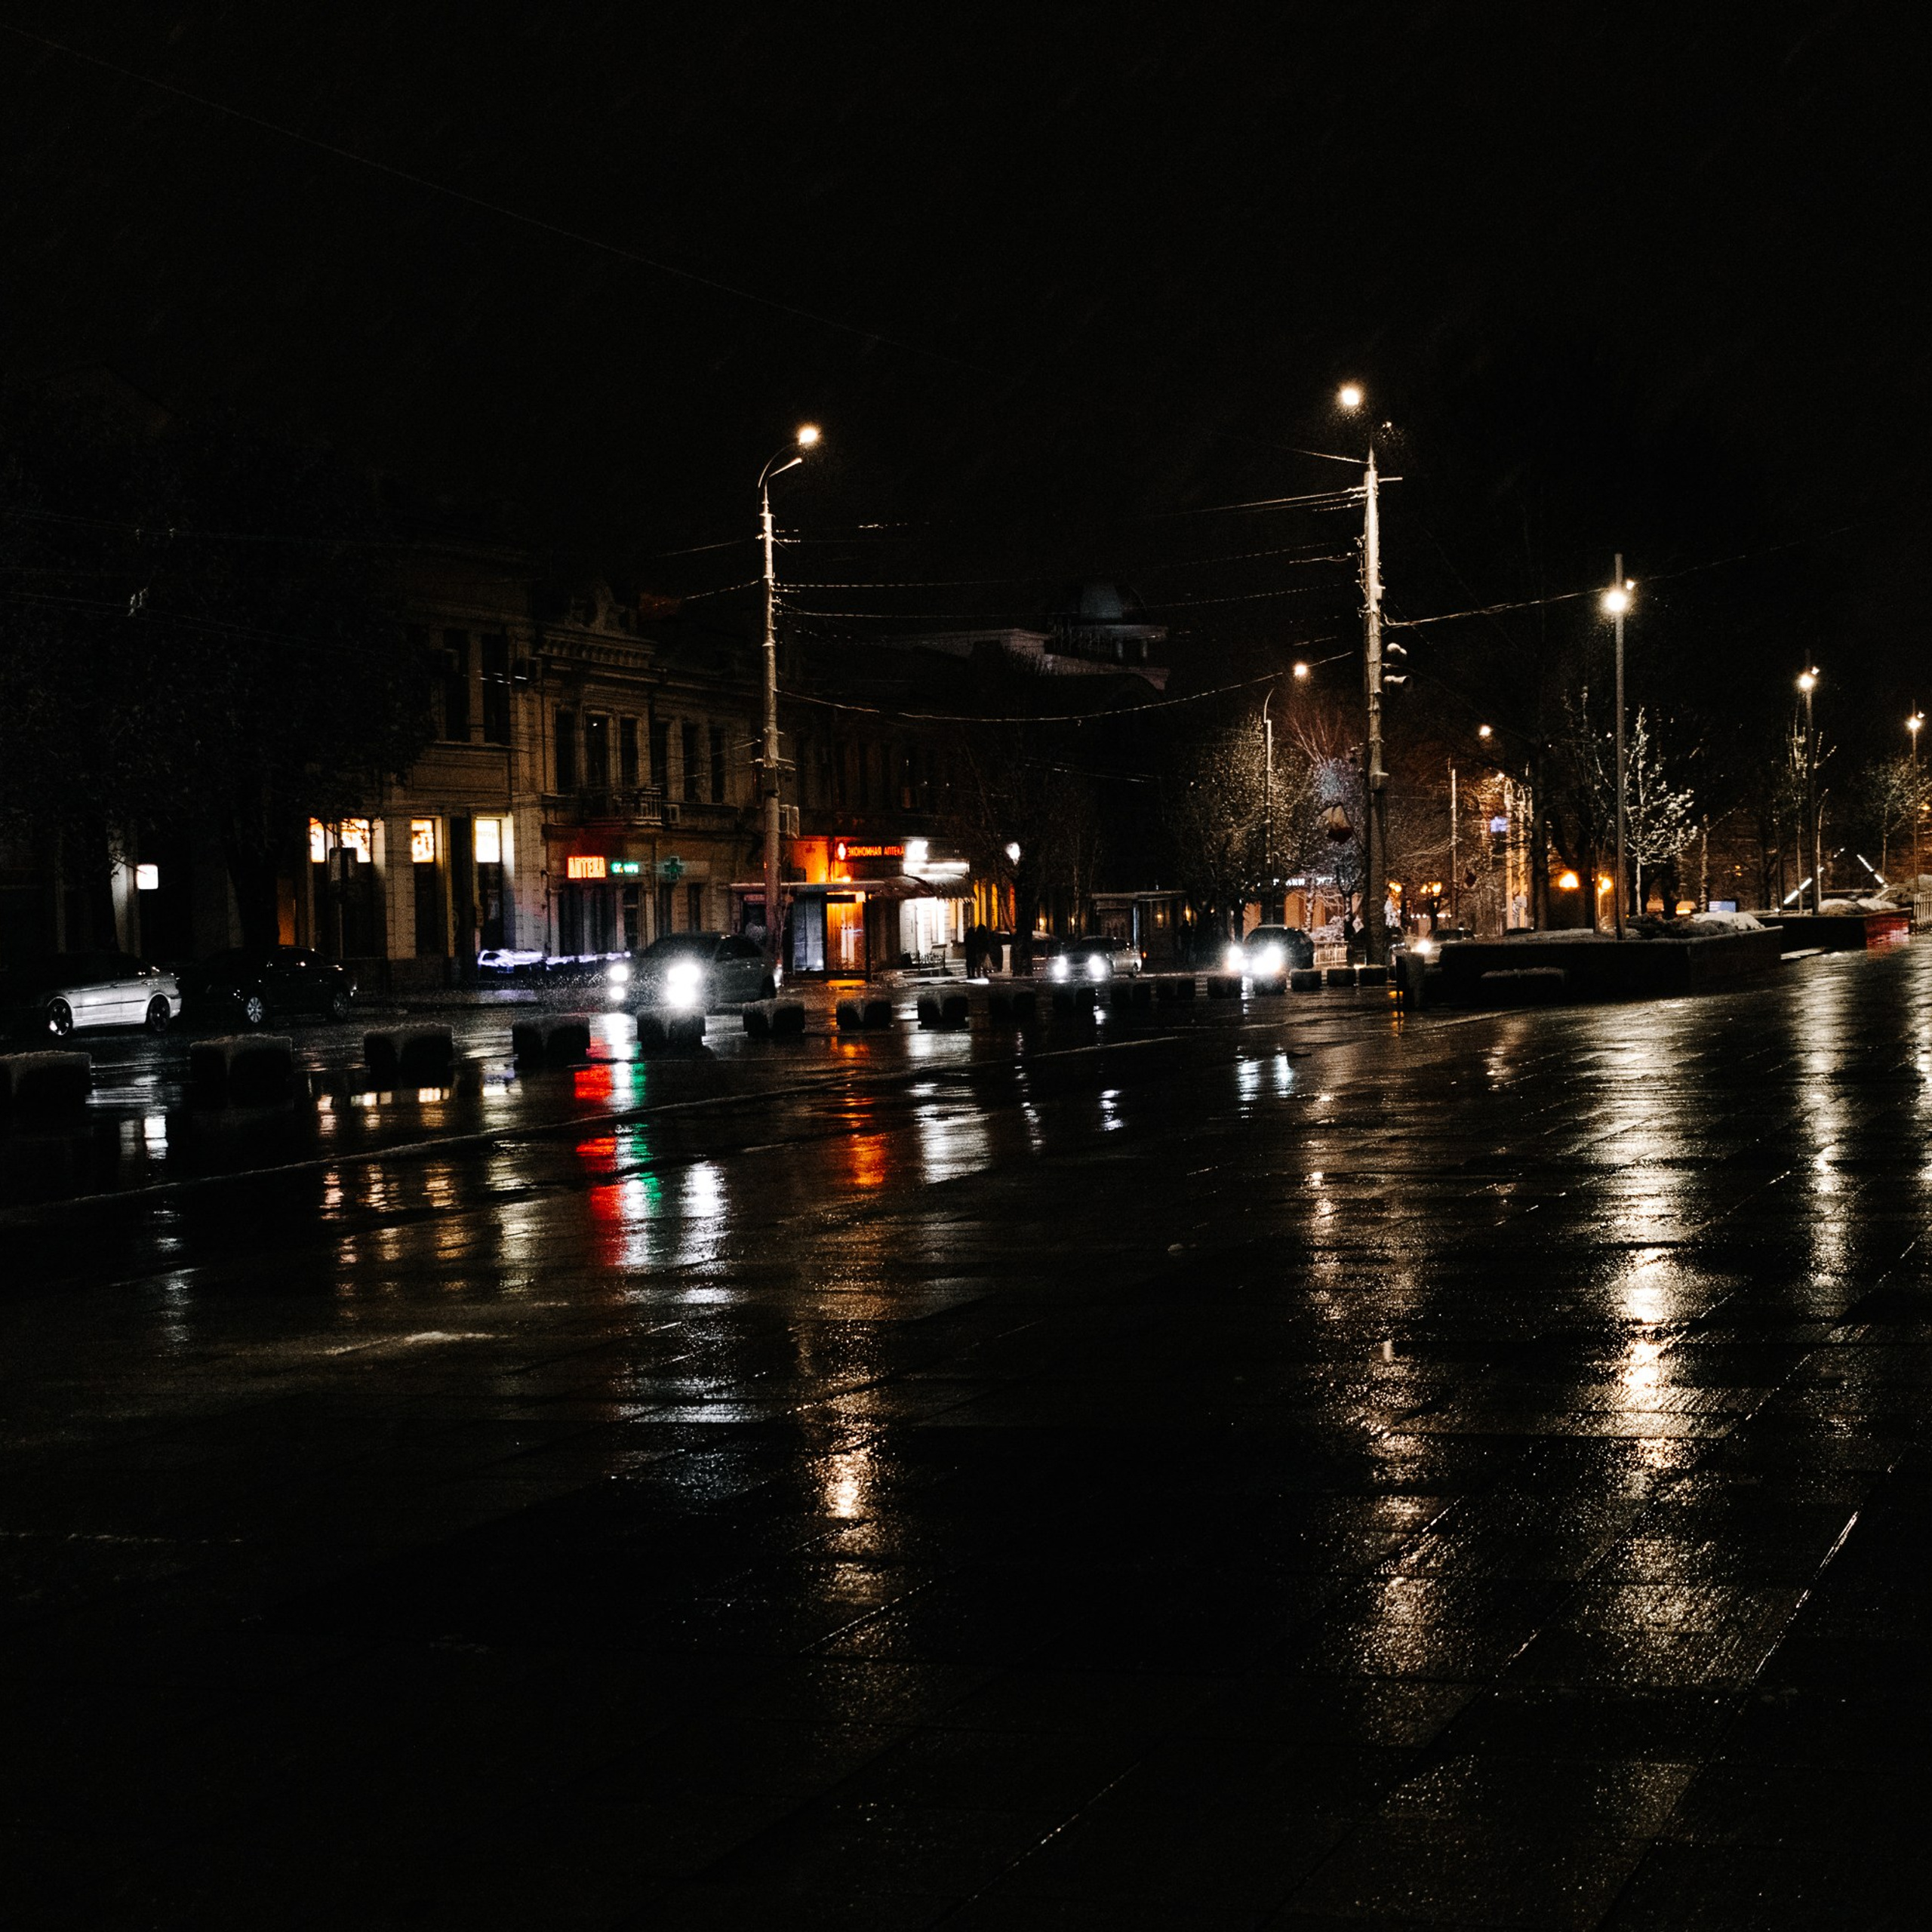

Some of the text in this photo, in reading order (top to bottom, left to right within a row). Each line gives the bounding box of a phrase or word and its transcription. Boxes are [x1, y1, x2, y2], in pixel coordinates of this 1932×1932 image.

[847, 846, 904, 857] ЭКОНОМНАЯ АПТЕКА
[568, 857, 605, 878] АПТЕКА
